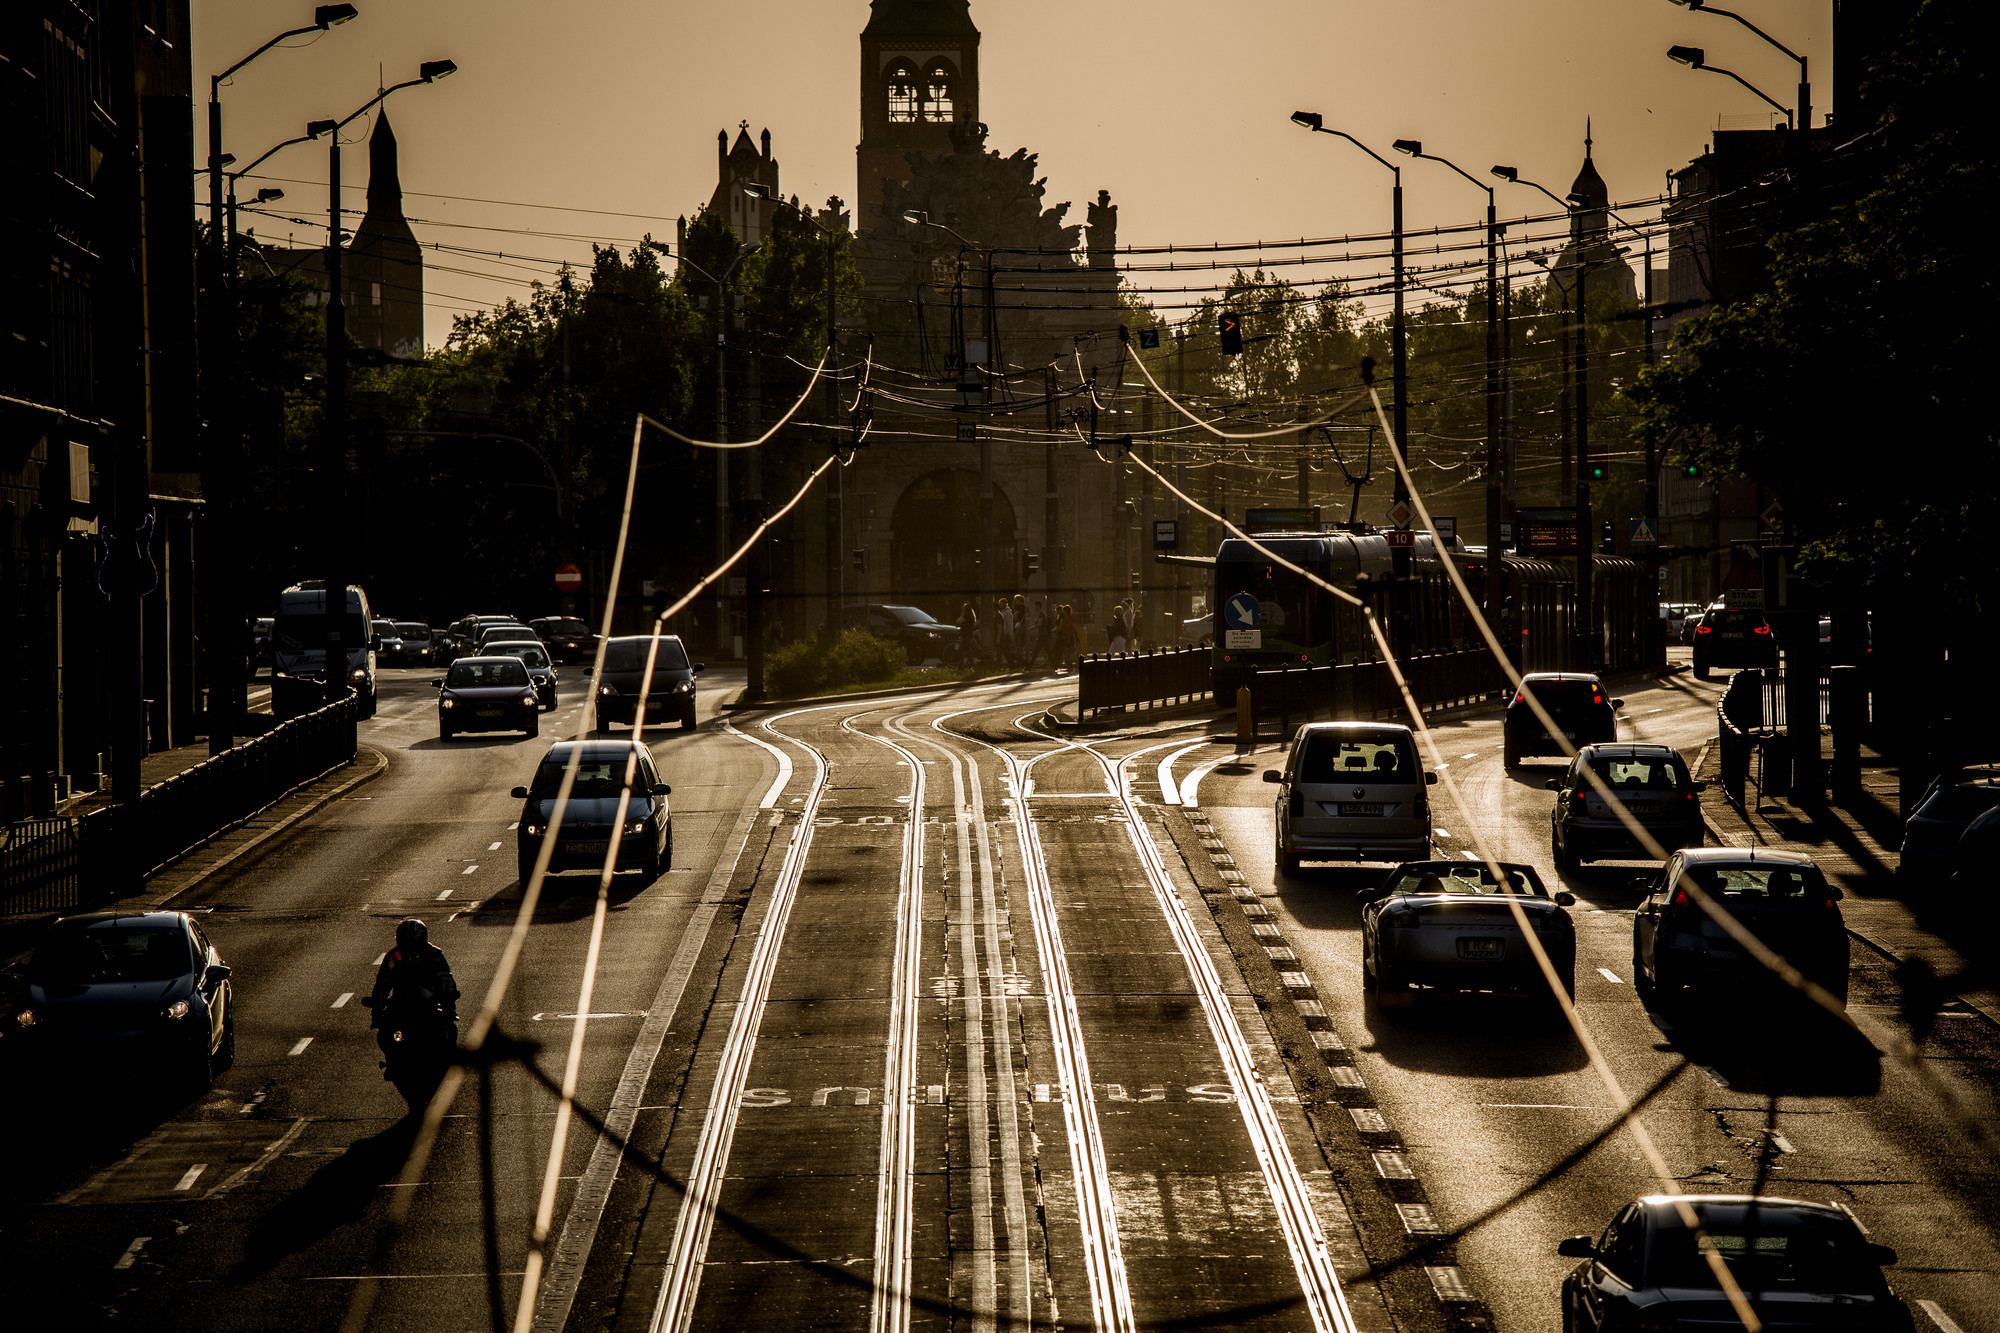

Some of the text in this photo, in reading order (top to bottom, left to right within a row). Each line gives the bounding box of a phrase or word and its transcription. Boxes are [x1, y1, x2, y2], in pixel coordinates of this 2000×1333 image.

[961, 428, 973, 439] 10
[1394, 533, 1408, 545] 10
[1768, 536, 1781, 547] 10
[1363, 805, 1382, 813] 9496
[1473, 939, 1489, 950] RZ
